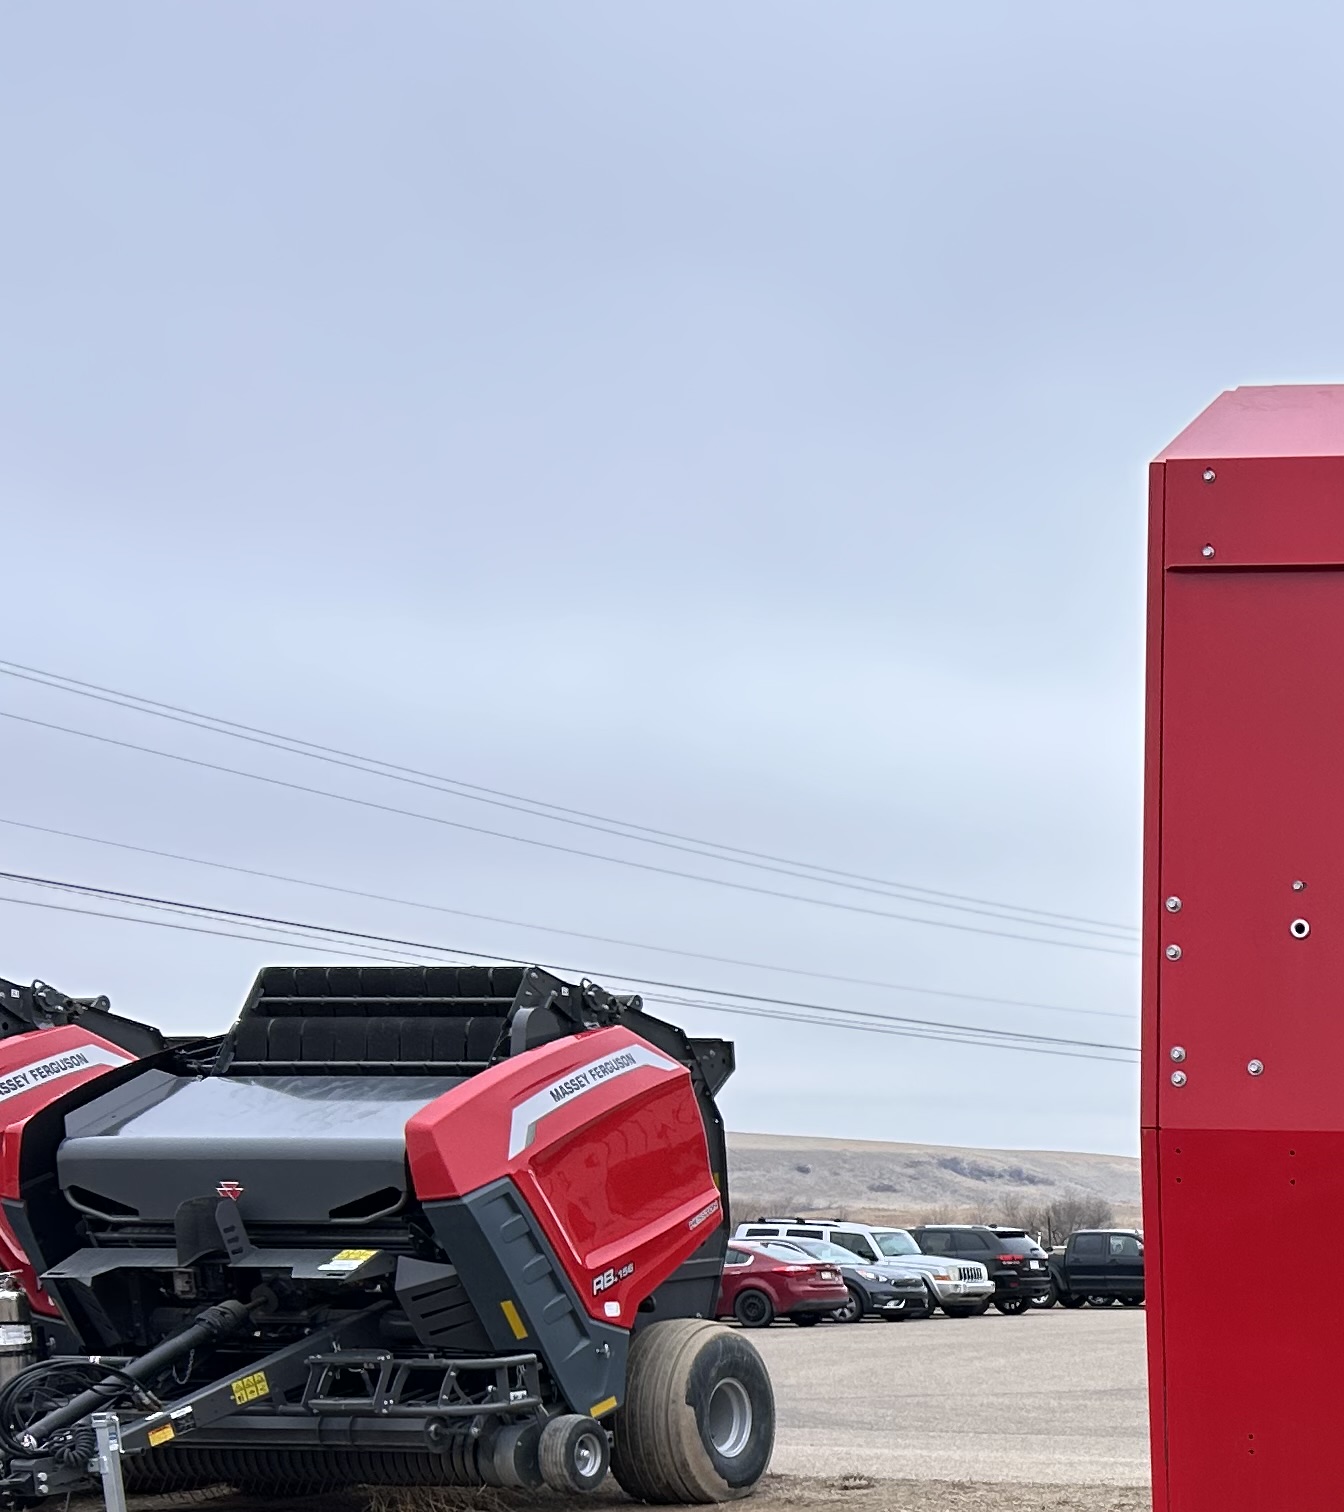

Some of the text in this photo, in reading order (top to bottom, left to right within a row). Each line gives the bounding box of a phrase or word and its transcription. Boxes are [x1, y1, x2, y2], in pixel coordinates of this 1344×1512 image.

[28, 1053, 89, 1081] FERGUSON
[549, 1053, 636, 1103] MASSEY FERGUSON
